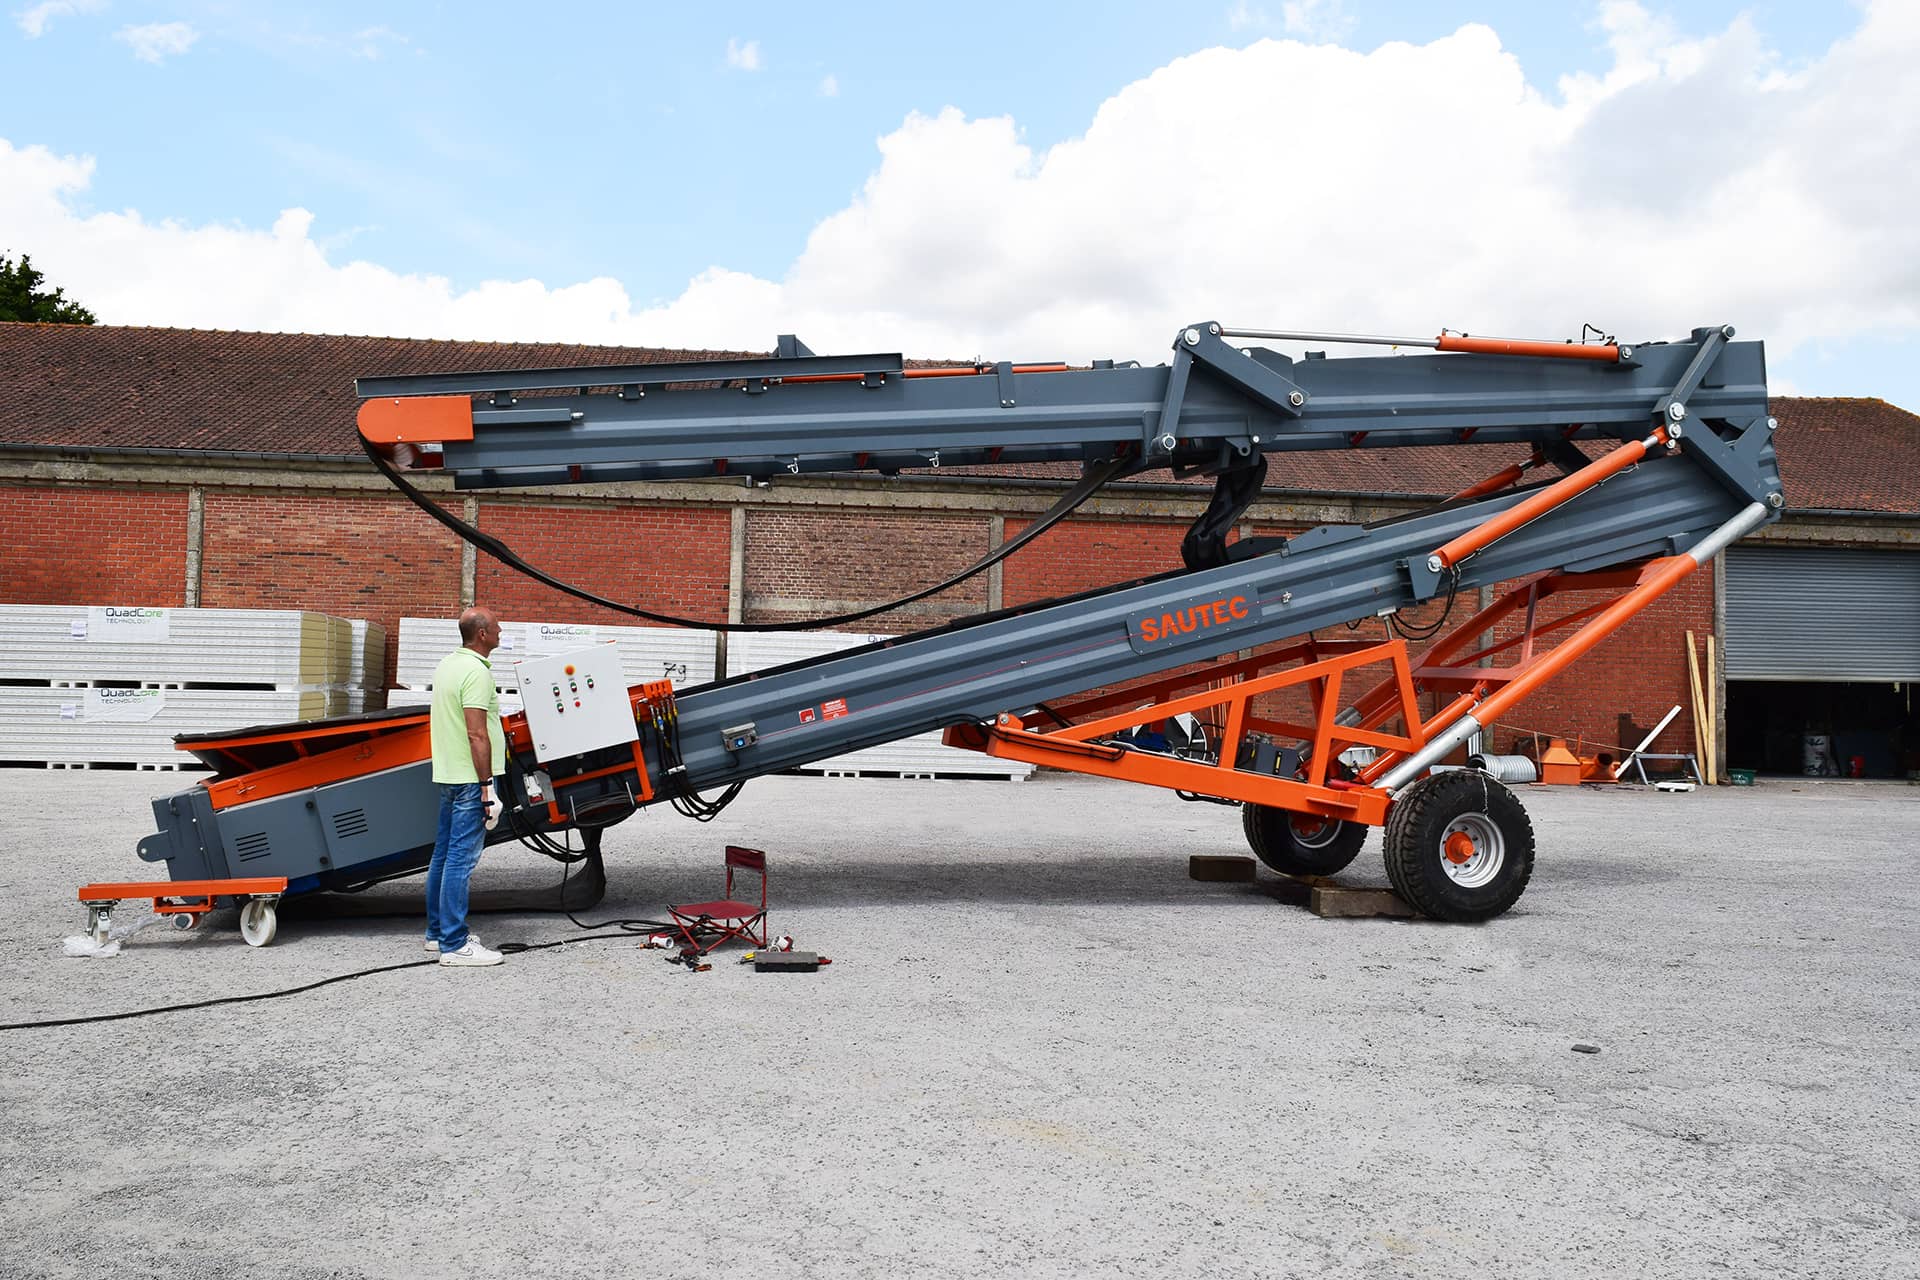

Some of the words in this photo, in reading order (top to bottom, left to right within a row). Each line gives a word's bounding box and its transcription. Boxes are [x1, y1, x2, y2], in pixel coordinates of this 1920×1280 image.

[105, 607, 164, 618] QuadCore
[1140, 595, 1249, 642] SAUTEC
[540, 625, 592, 636] QuadCore
